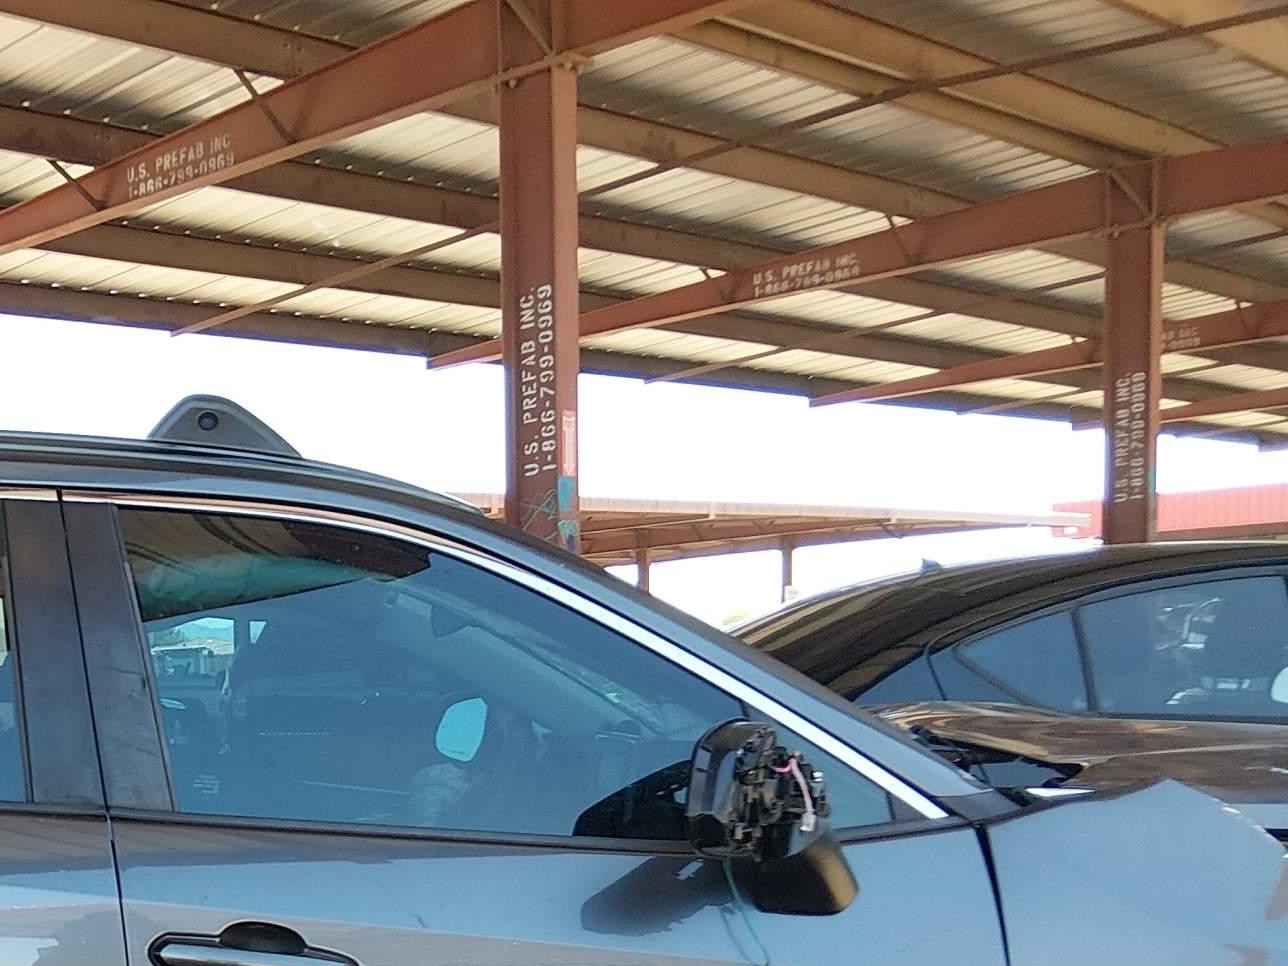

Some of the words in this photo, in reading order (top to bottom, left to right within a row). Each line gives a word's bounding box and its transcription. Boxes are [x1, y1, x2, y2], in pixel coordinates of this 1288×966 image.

[127, 162, 150, 183] U.S.
[155, 141, 203, 171] PREFAB
[210, 134, 231, 154] INC
[520, 286, 536, 330] INC.
[521, 340, 538, 424] PREFAB
[537, 284, 557, 471] 1-866-799-0969
[524, 434, 540, 477] U.S.
